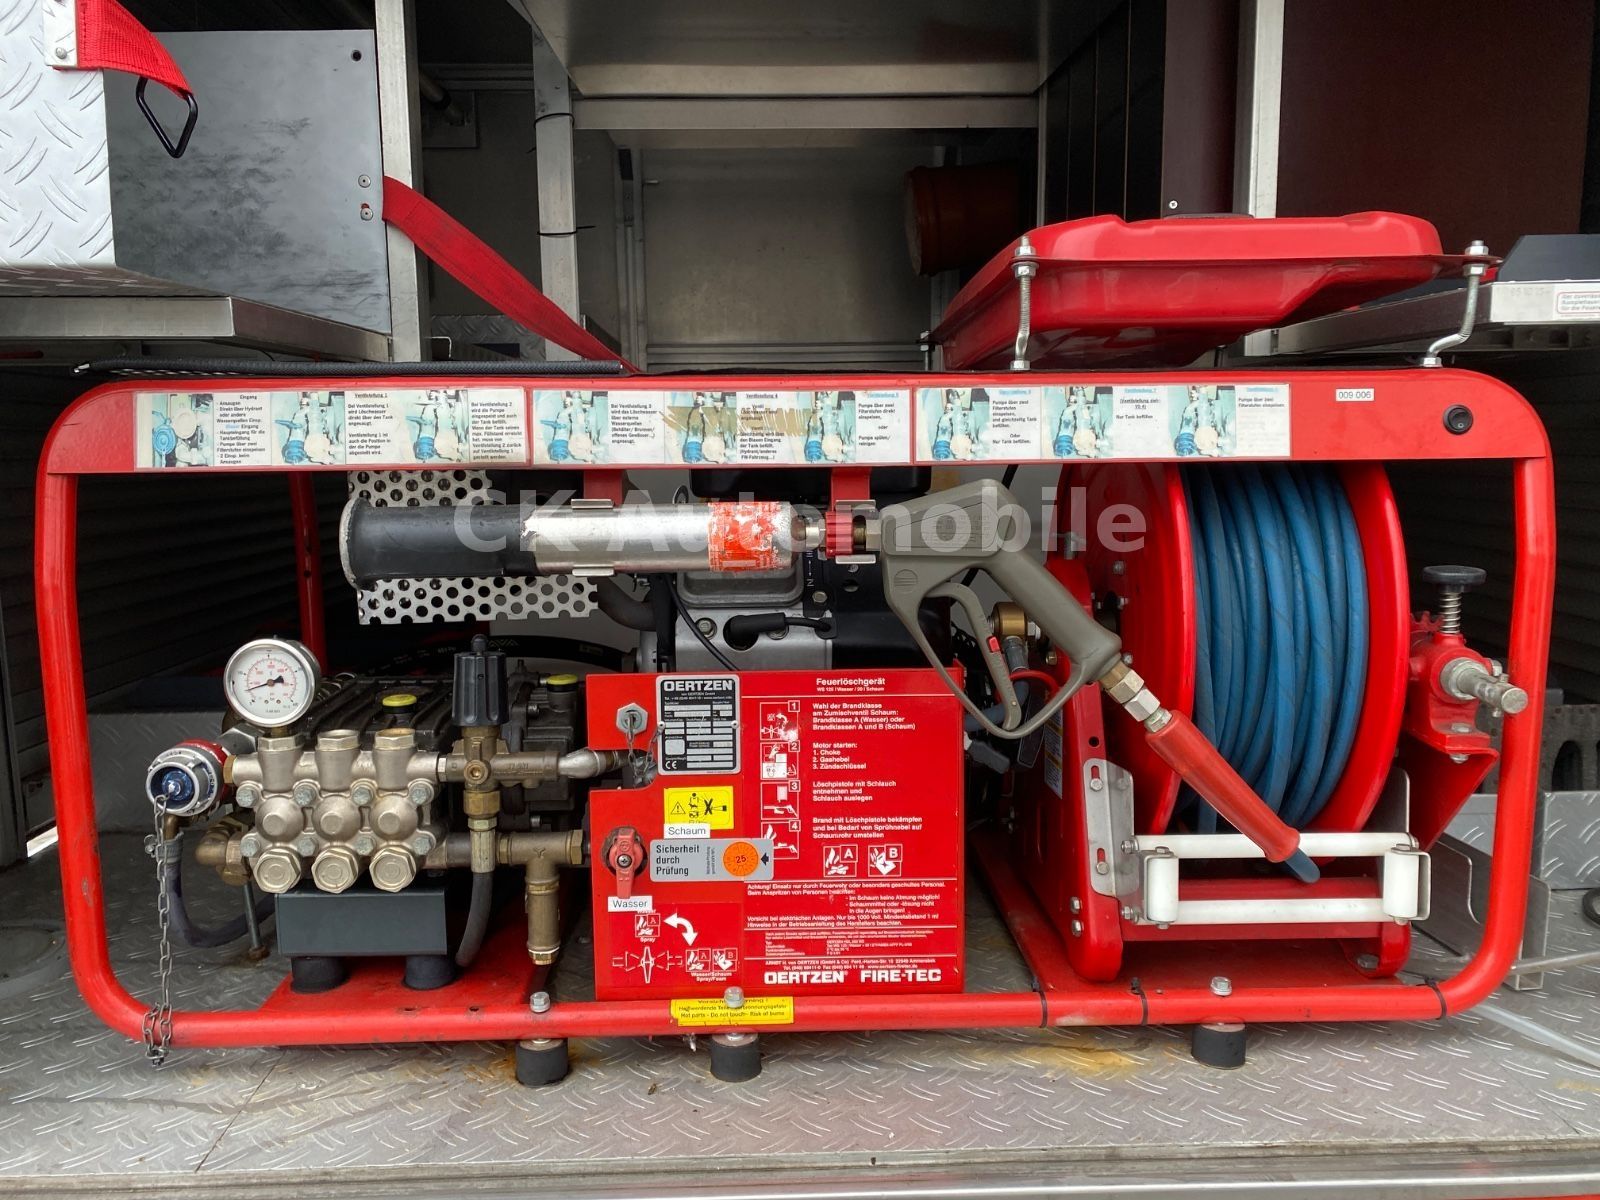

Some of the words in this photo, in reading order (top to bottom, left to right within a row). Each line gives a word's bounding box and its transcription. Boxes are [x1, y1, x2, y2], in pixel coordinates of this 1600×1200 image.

[664, 680, 732, 691] OERTZEN
[816, 677, 885, 686] Feuerlöschgerät
[668, 827, 706, 835] Schaum
[656, 845, 700, 854] Sicherheit
[844, 848, 853, 858] A
[889, 848, 898, 858] B
[656, 856, 680, 864] durch
[736, 855, 746, 863] 25
[656, 867, 689, 876] Prüfung
[764, 971, 844, 984] OERTZEN
